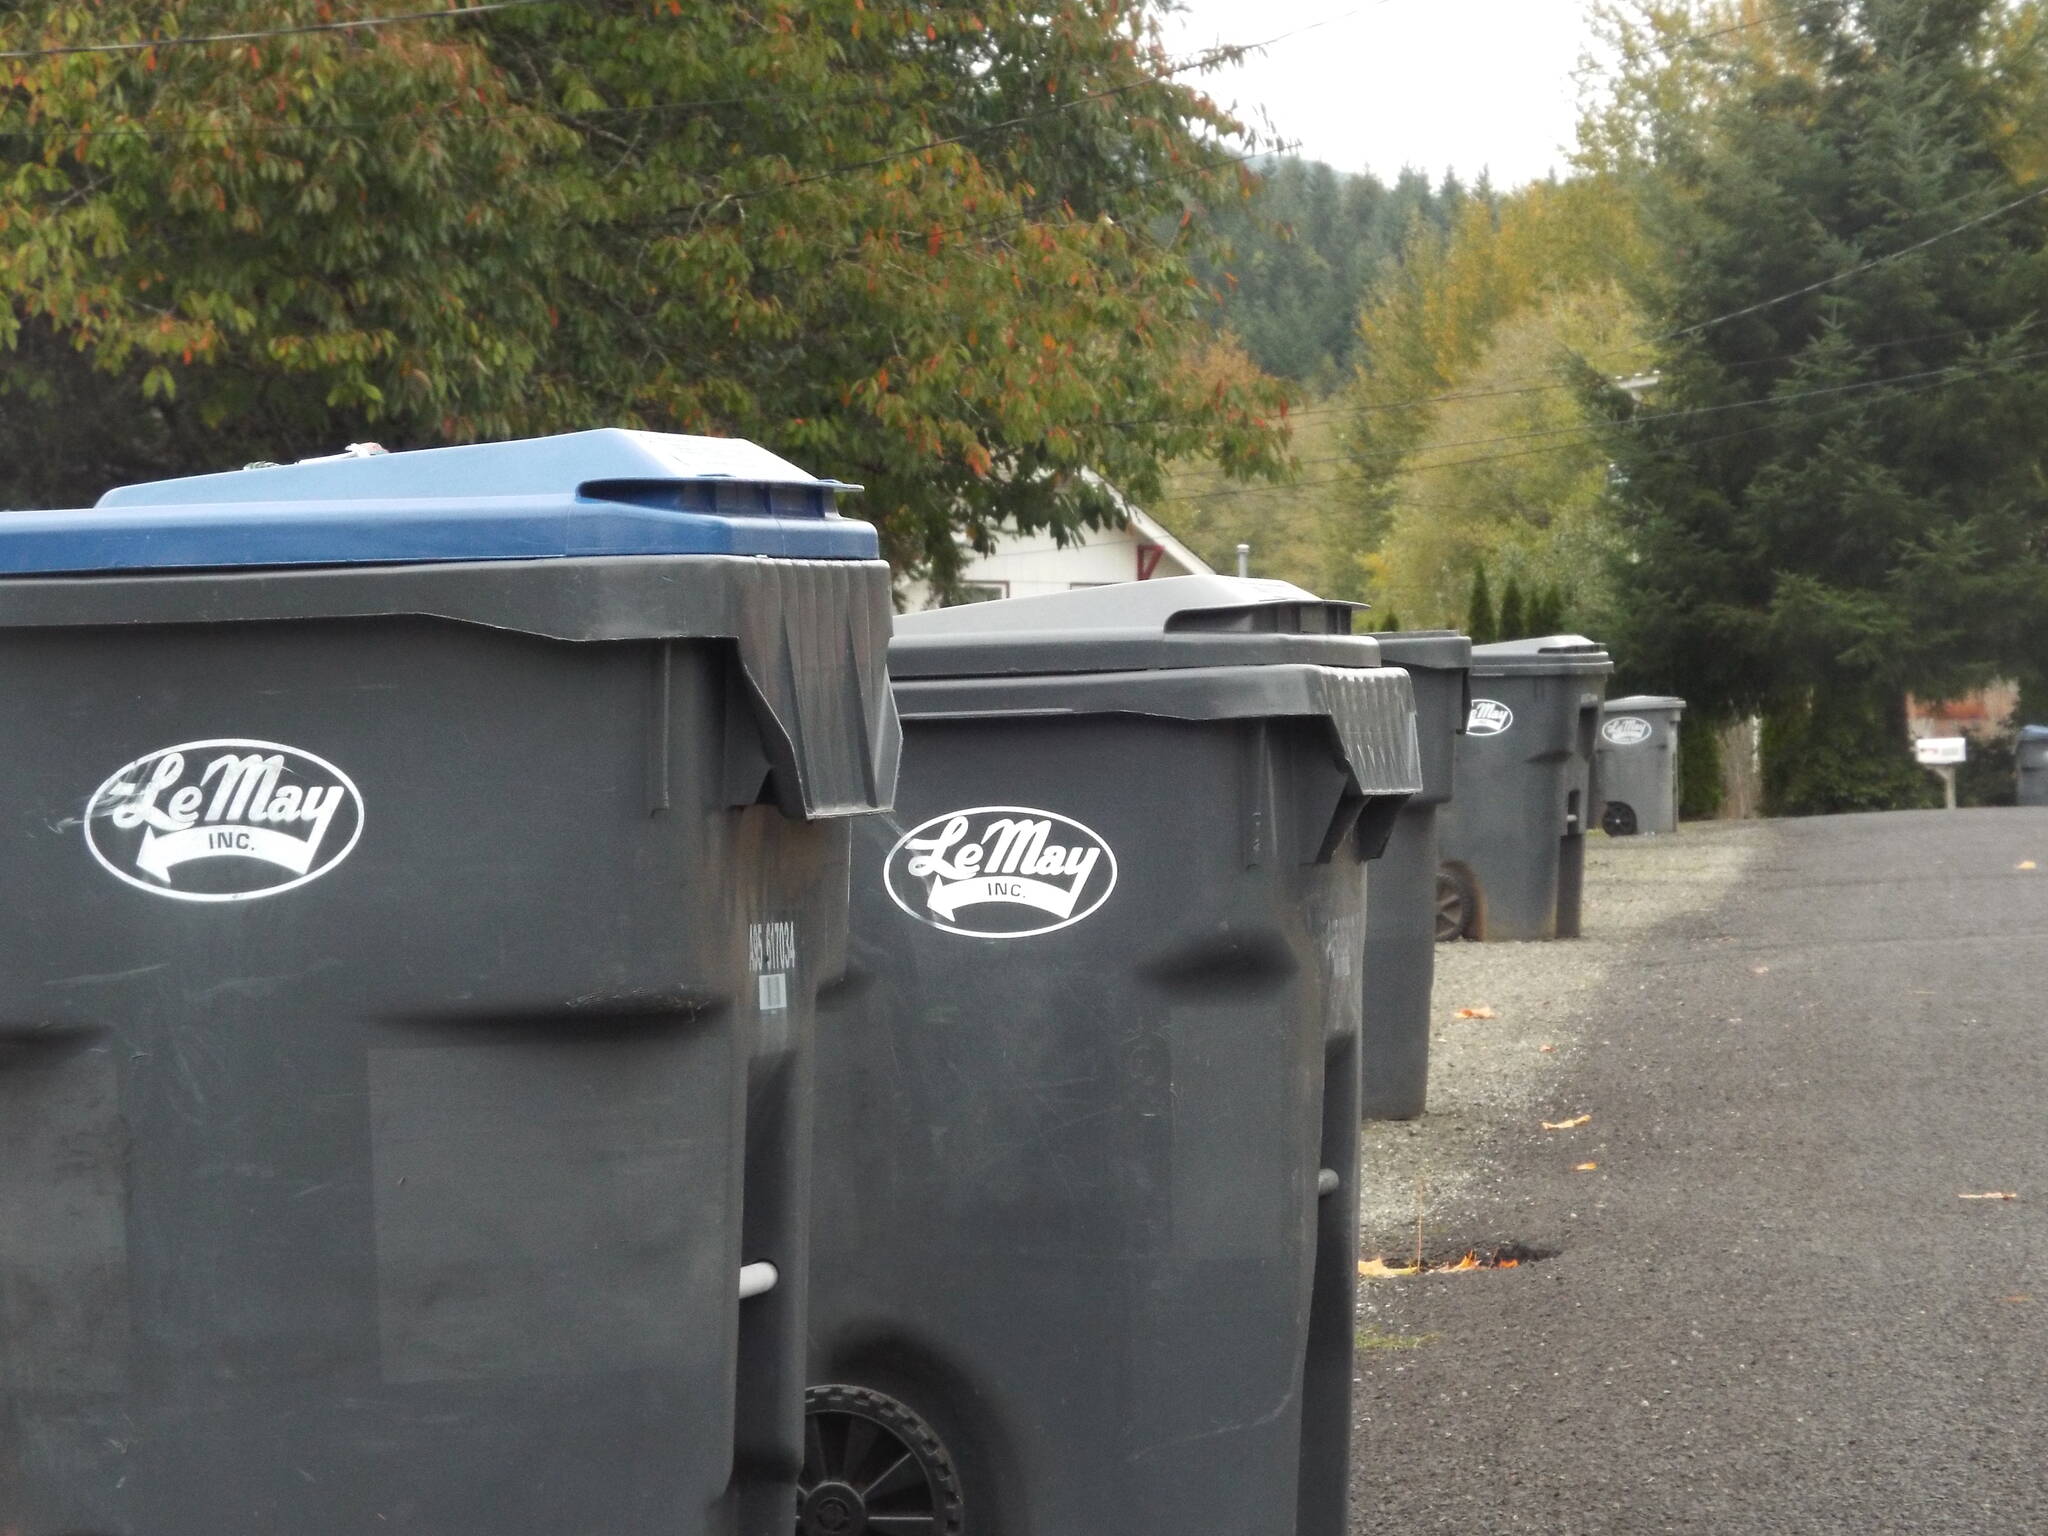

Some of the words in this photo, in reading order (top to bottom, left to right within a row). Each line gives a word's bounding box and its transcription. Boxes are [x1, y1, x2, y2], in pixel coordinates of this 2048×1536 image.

[1469, 703, 1509, 720] eMay
[109, 753, 345, 842] LeMay
[209, 832, 254, 851] INC.
[905, 815, 1101, 888] LeMay
[987, 882, 1026, 898] INC.
